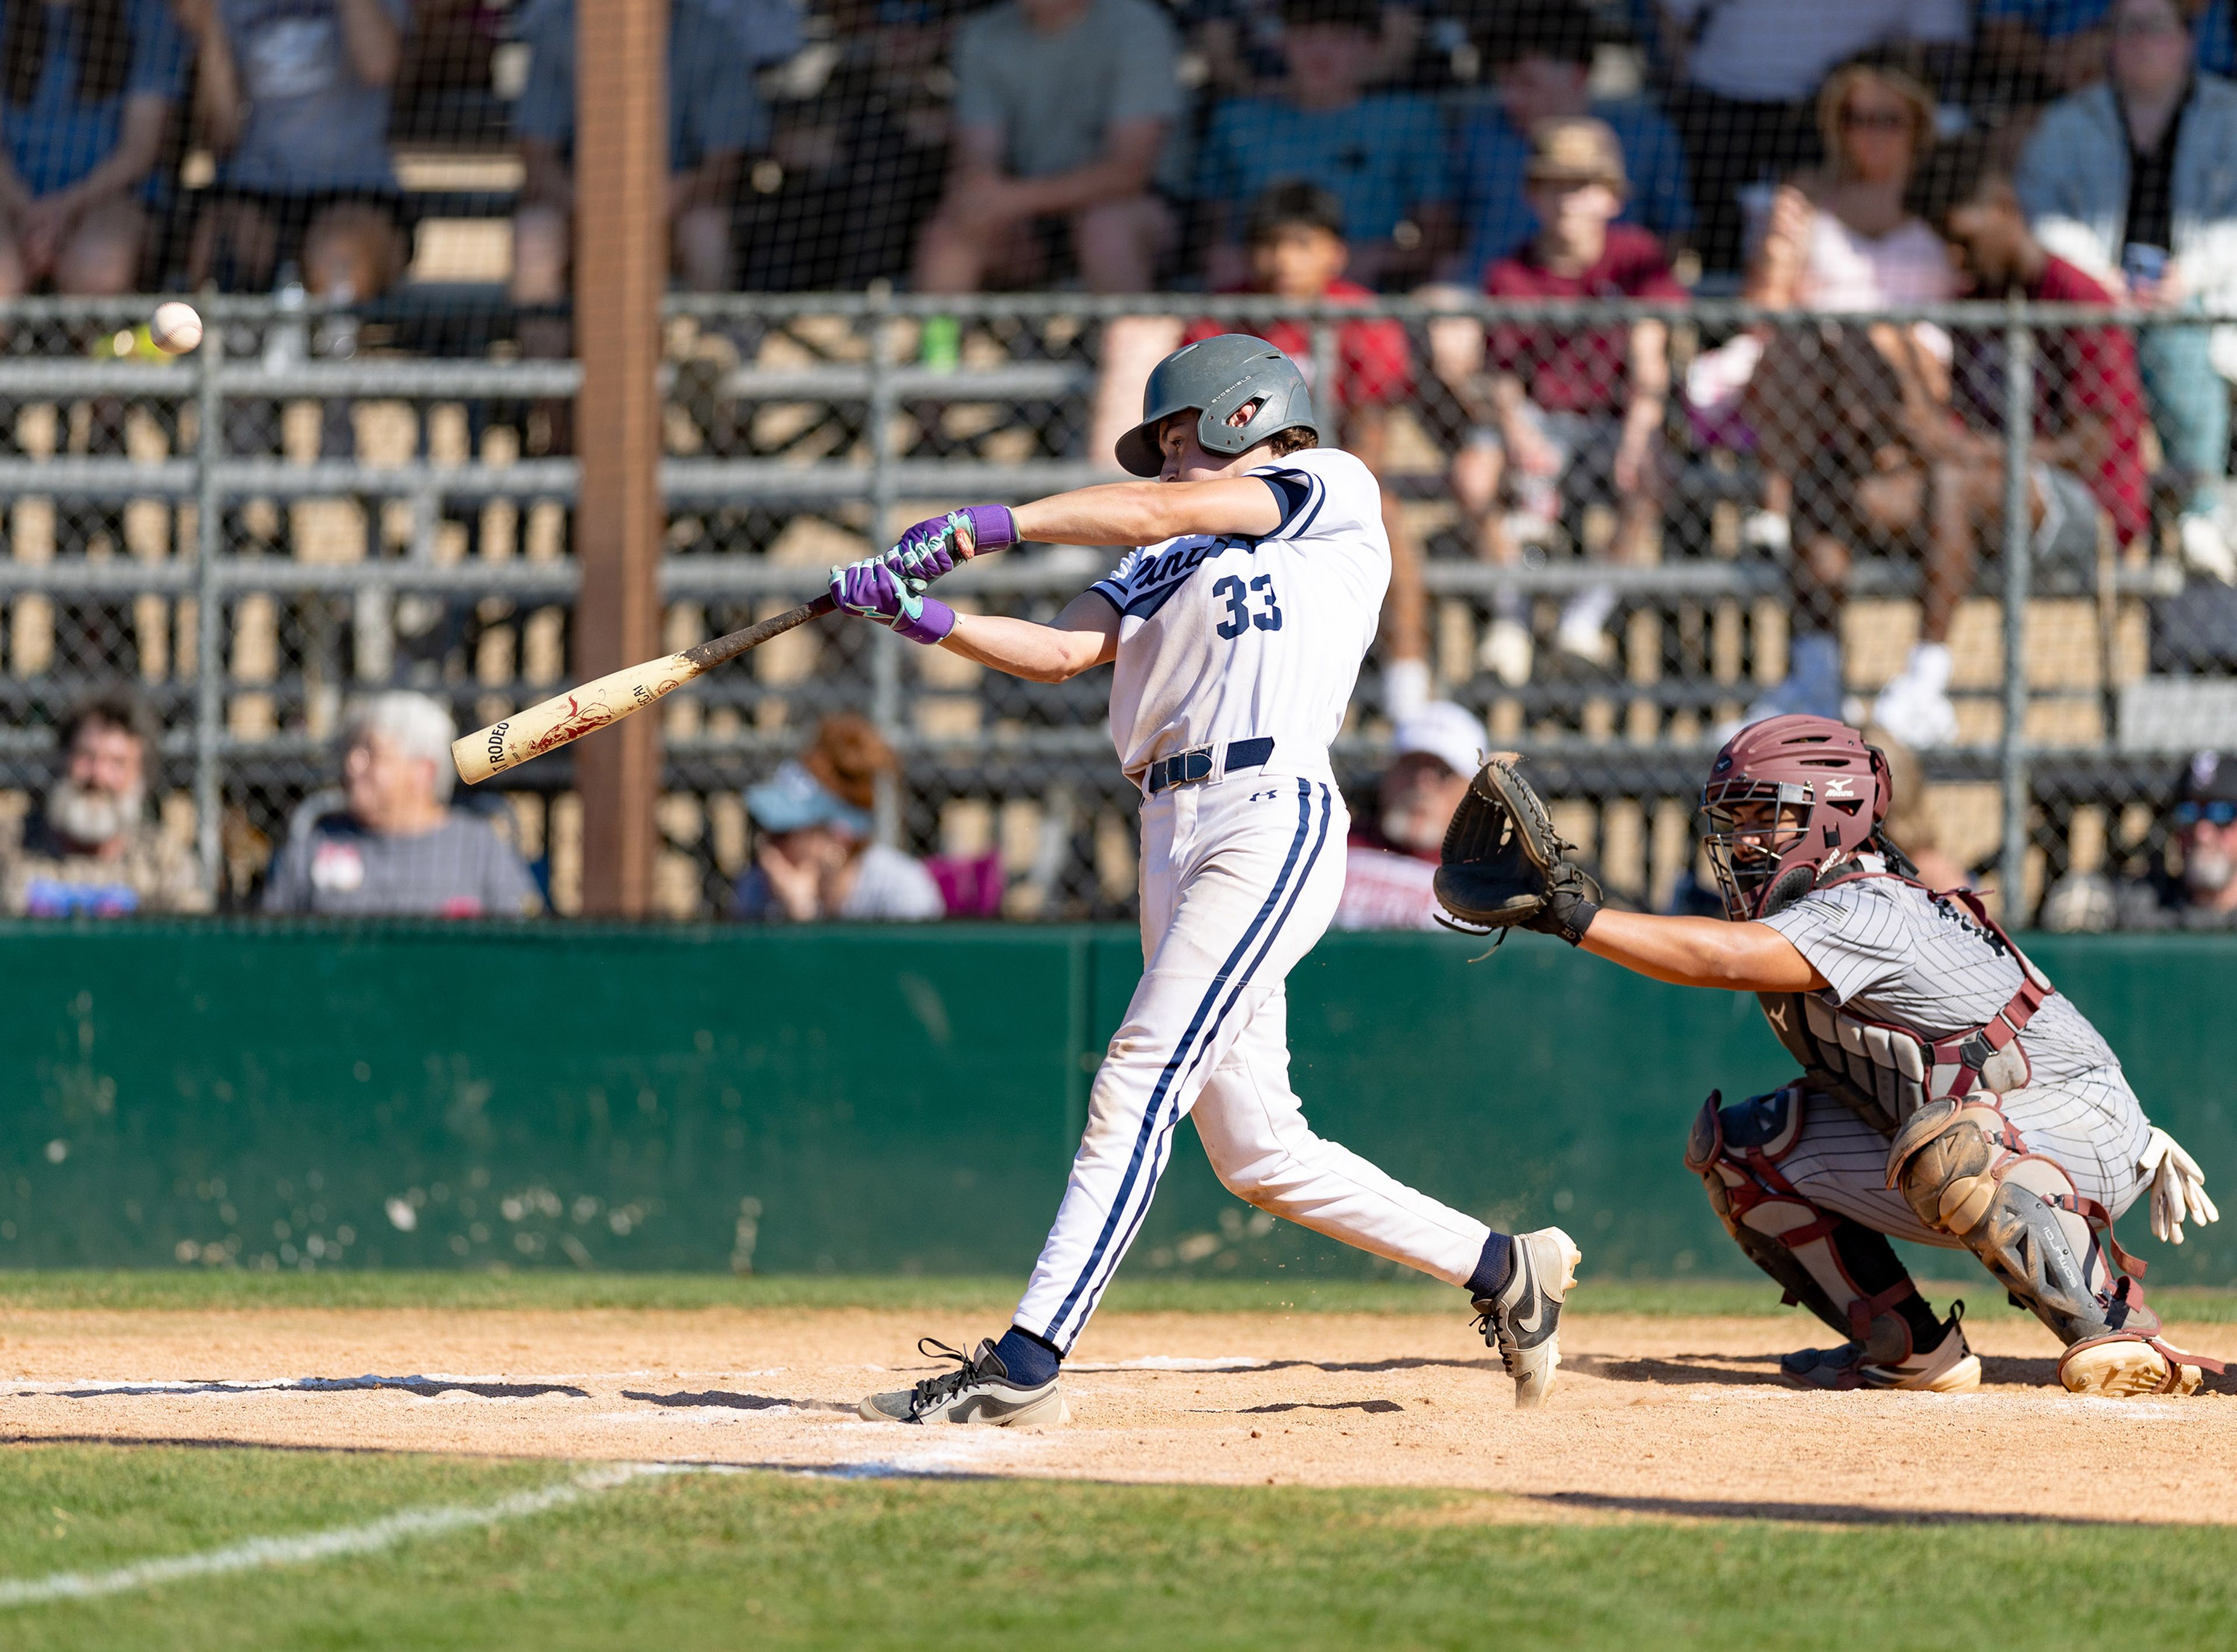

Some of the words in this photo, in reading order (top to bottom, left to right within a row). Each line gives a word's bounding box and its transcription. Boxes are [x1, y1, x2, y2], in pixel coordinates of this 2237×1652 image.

[1211, 375, 1252, 404] EVOSHIELD
[1212, 573, 1283, 641] 33
[488, 722, 510, 764] RODEO
